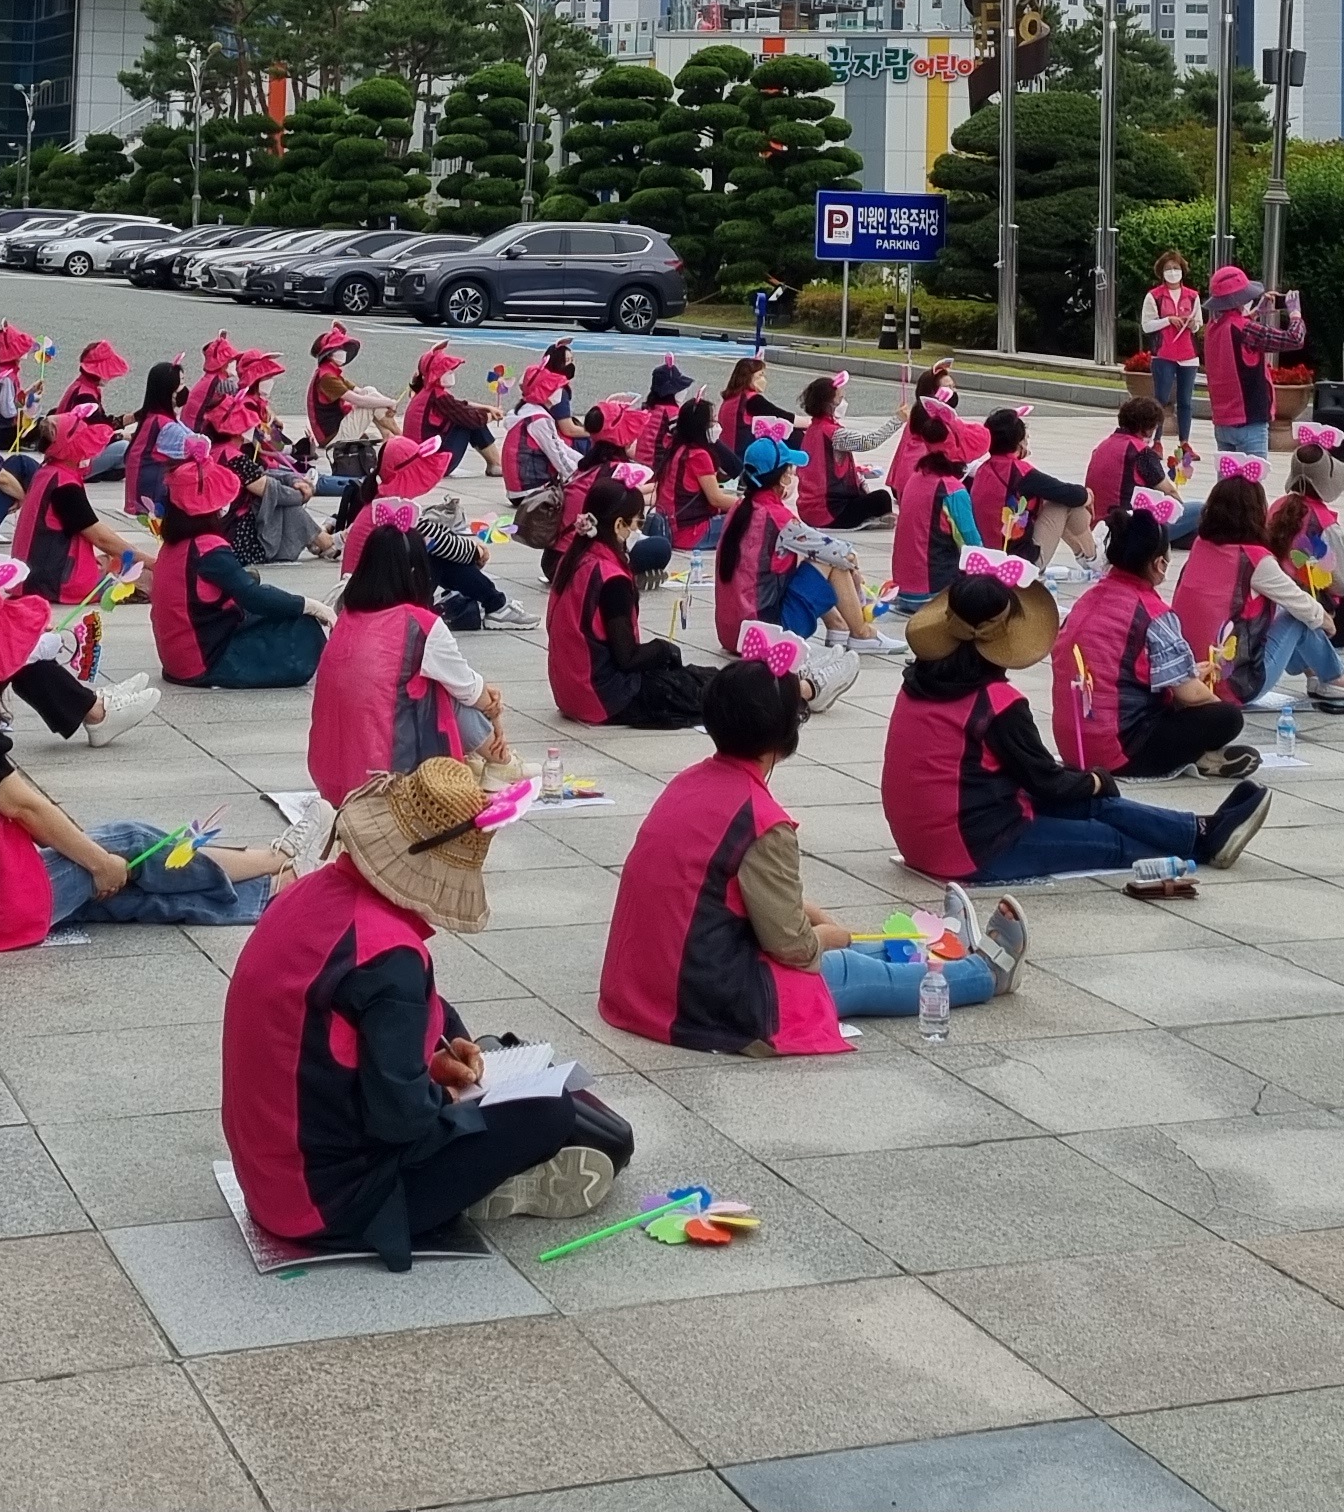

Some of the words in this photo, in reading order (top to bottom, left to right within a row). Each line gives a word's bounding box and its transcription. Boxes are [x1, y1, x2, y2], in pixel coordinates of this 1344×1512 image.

[827, 45, 915, 83] 꿈자람
[857, 207, 888, 234] 민원인
[889, 208, 939, 236] 전용주차장
[875, 239, 920, 250] PARKING
